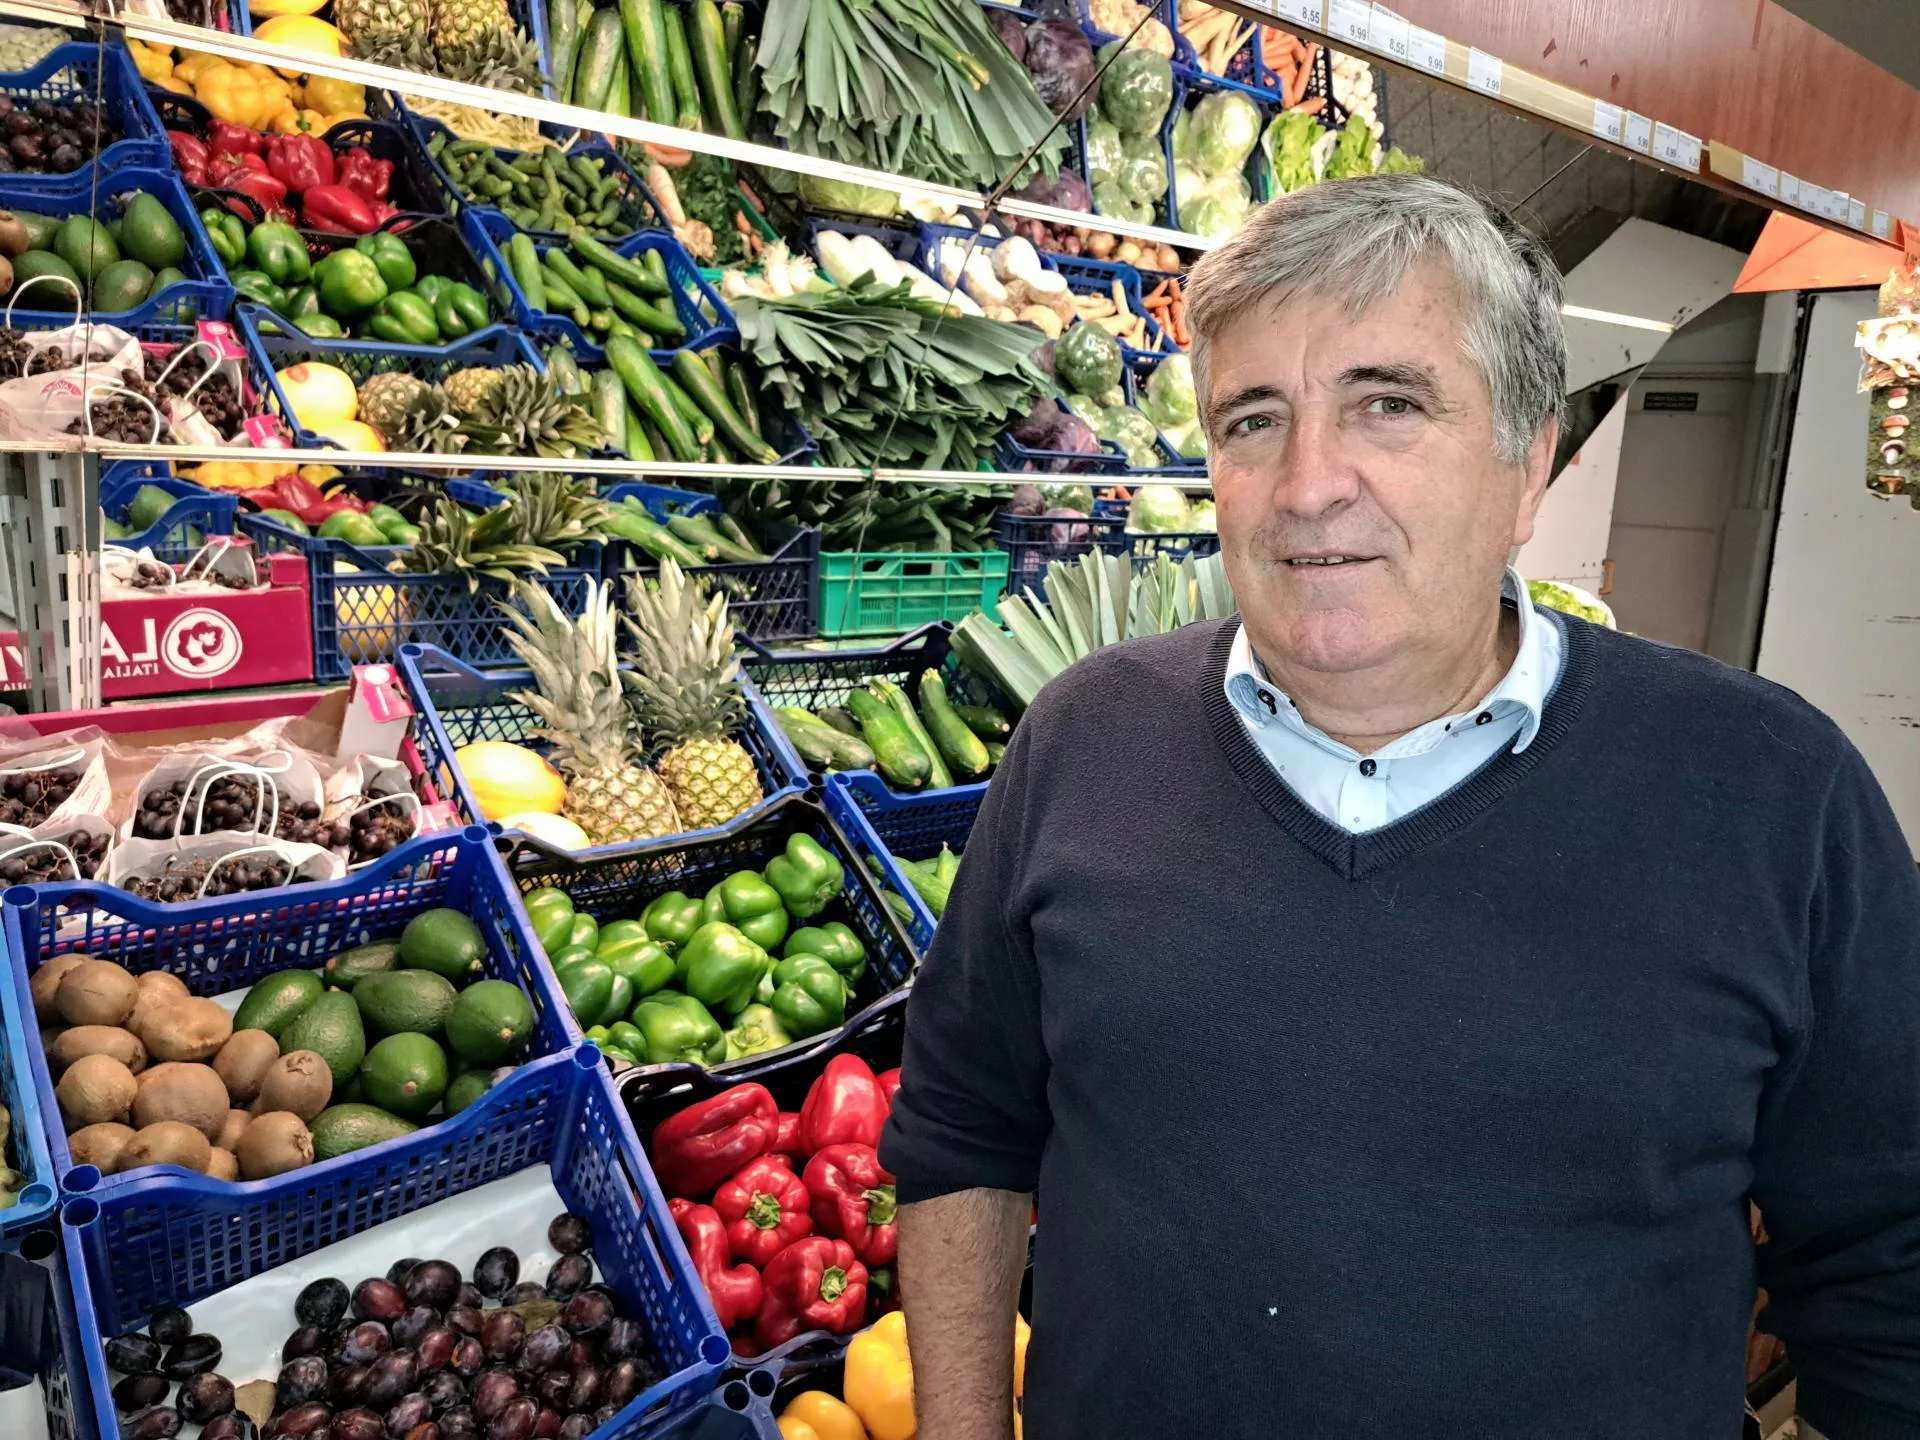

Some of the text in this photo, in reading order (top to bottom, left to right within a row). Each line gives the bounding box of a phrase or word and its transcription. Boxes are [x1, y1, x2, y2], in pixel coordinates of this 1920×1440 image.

[1302, 7, 1320, 24] 8,55
[1350, 24, 1367, 41] 9,99
[1428, 56, 1443, 71] 9,99
